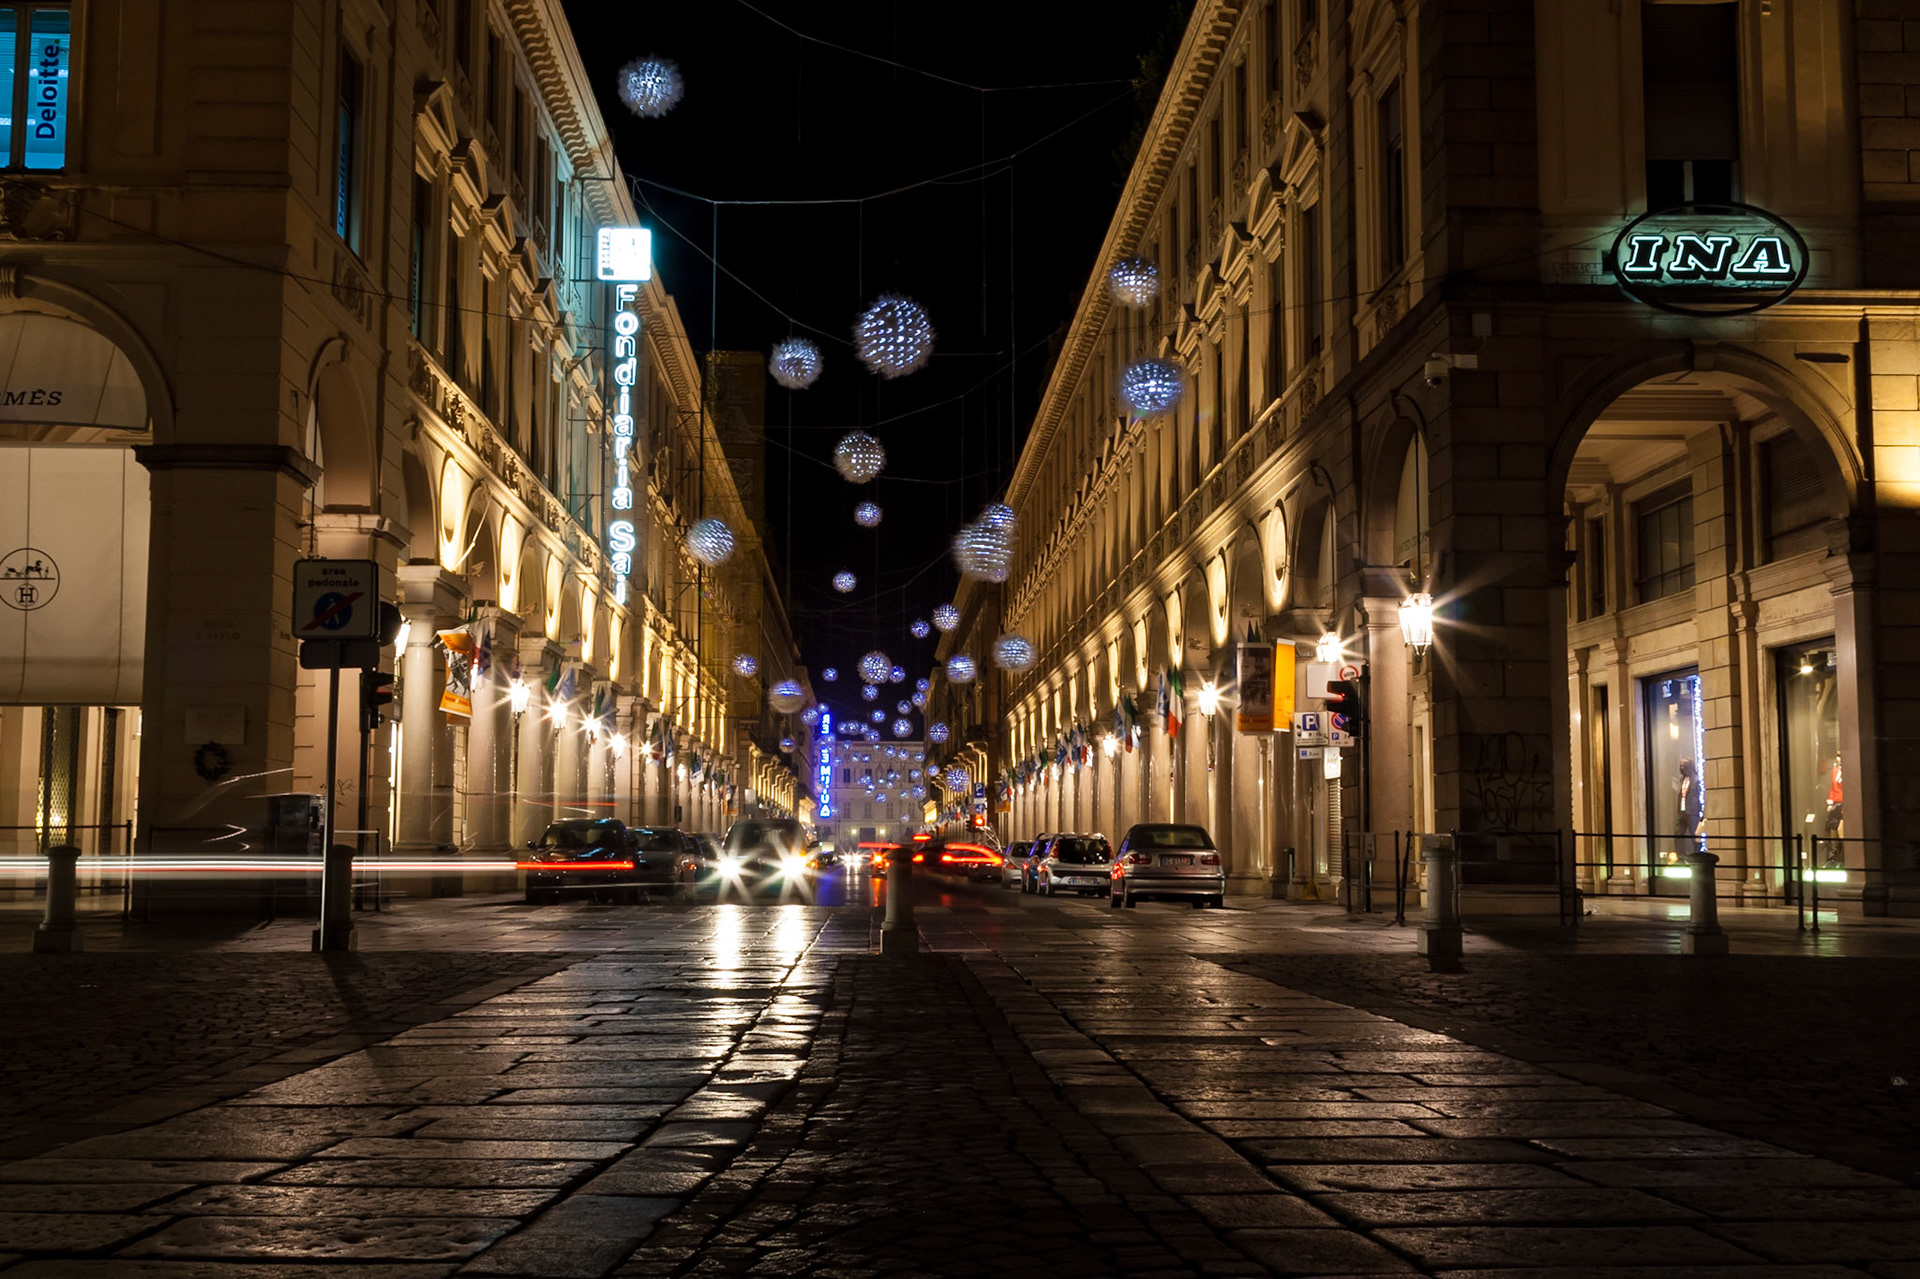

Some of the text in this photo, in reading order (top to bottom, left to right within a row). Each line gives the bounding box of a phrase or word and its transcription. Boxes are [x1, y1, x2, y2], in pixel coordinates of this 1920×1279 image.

[1624, 235, 1795, 279] INA
[0, 389, 62, 406] MÈS
[609, 284, 639, 605] Fondiaria Sai
[322, 568, 346, 576] area
[308, 578, 360, 588] pedonale
[1306, 715, 1315, 729] P
